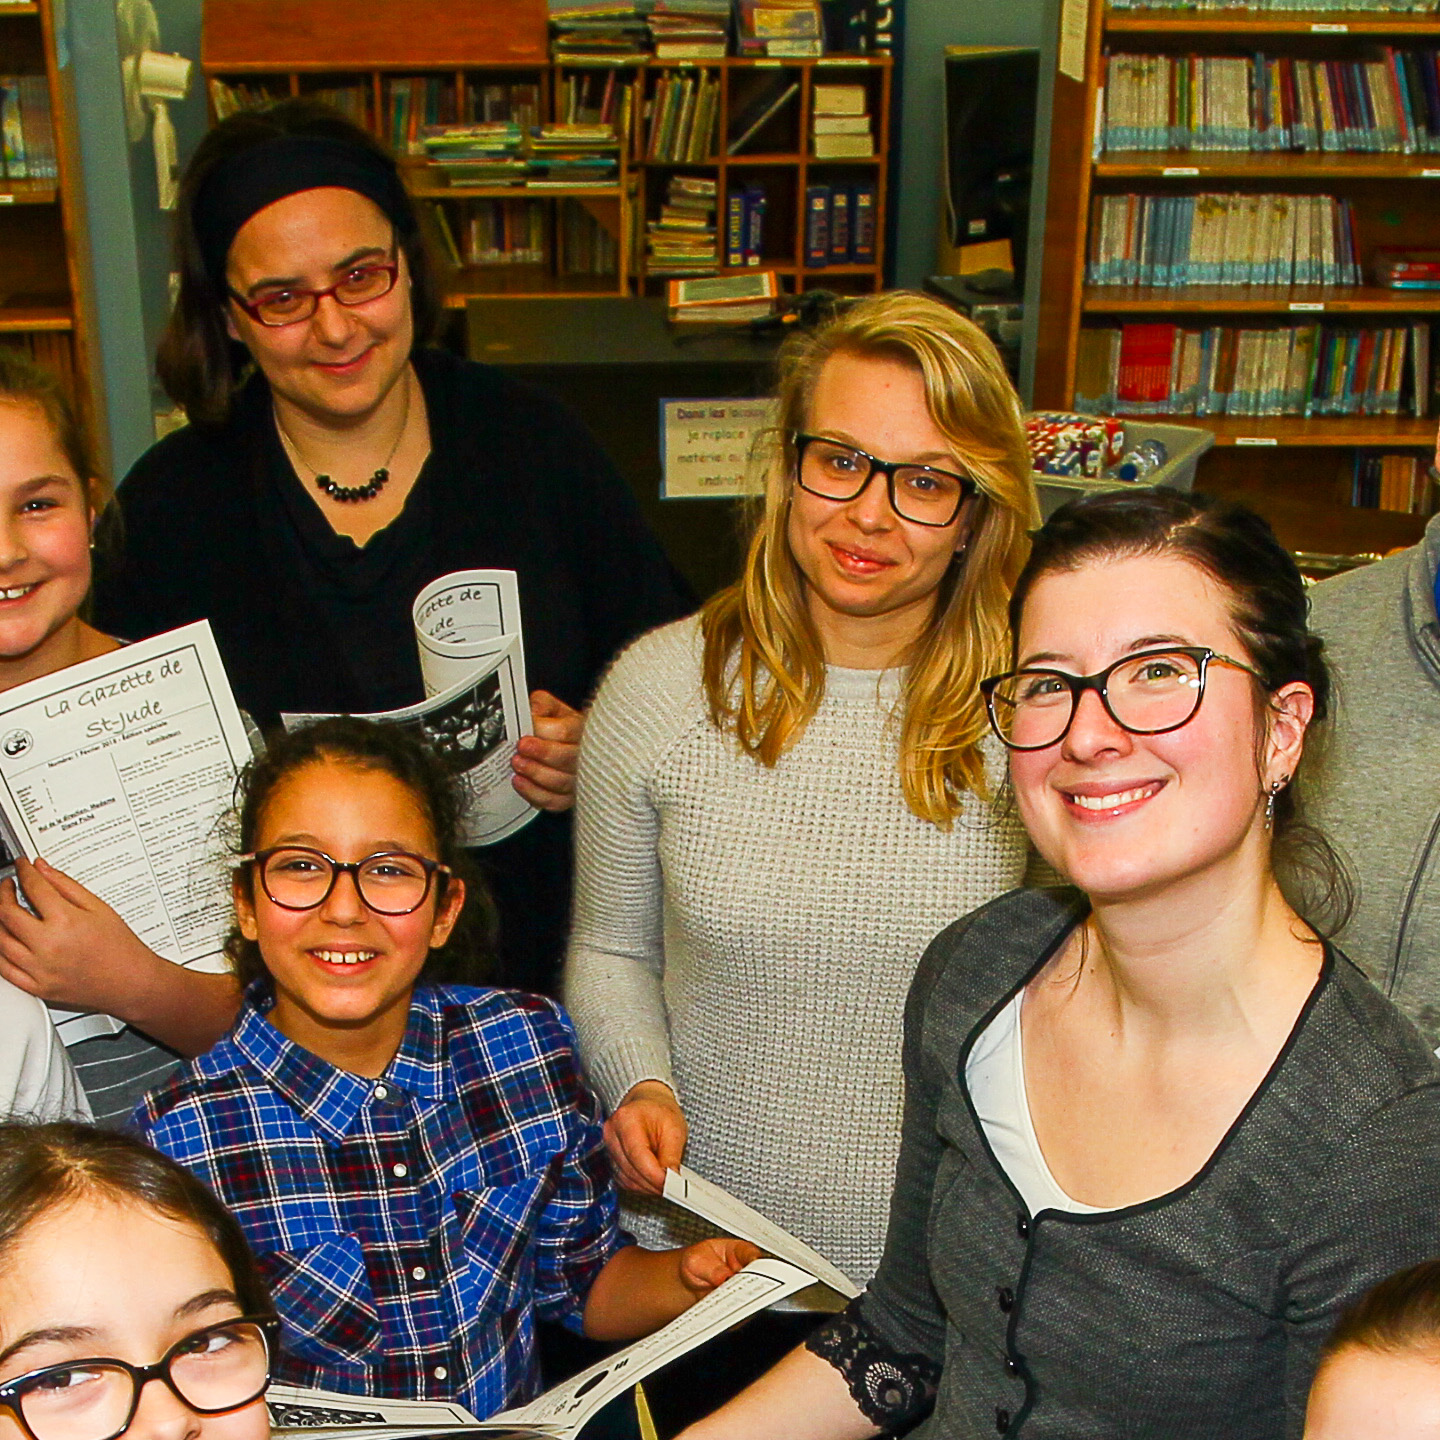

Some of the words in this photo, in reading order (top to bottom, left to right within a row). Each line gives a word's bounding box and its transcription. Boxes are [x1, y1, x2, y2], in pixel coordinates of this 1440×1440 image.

[460, 588, 481, 601] de
[44, 700, 71, 719] La
[78, 670, 154, 707] Gazette
[160, 659, 182, 678] de
[86, 700, 163, 738] St-Jude
